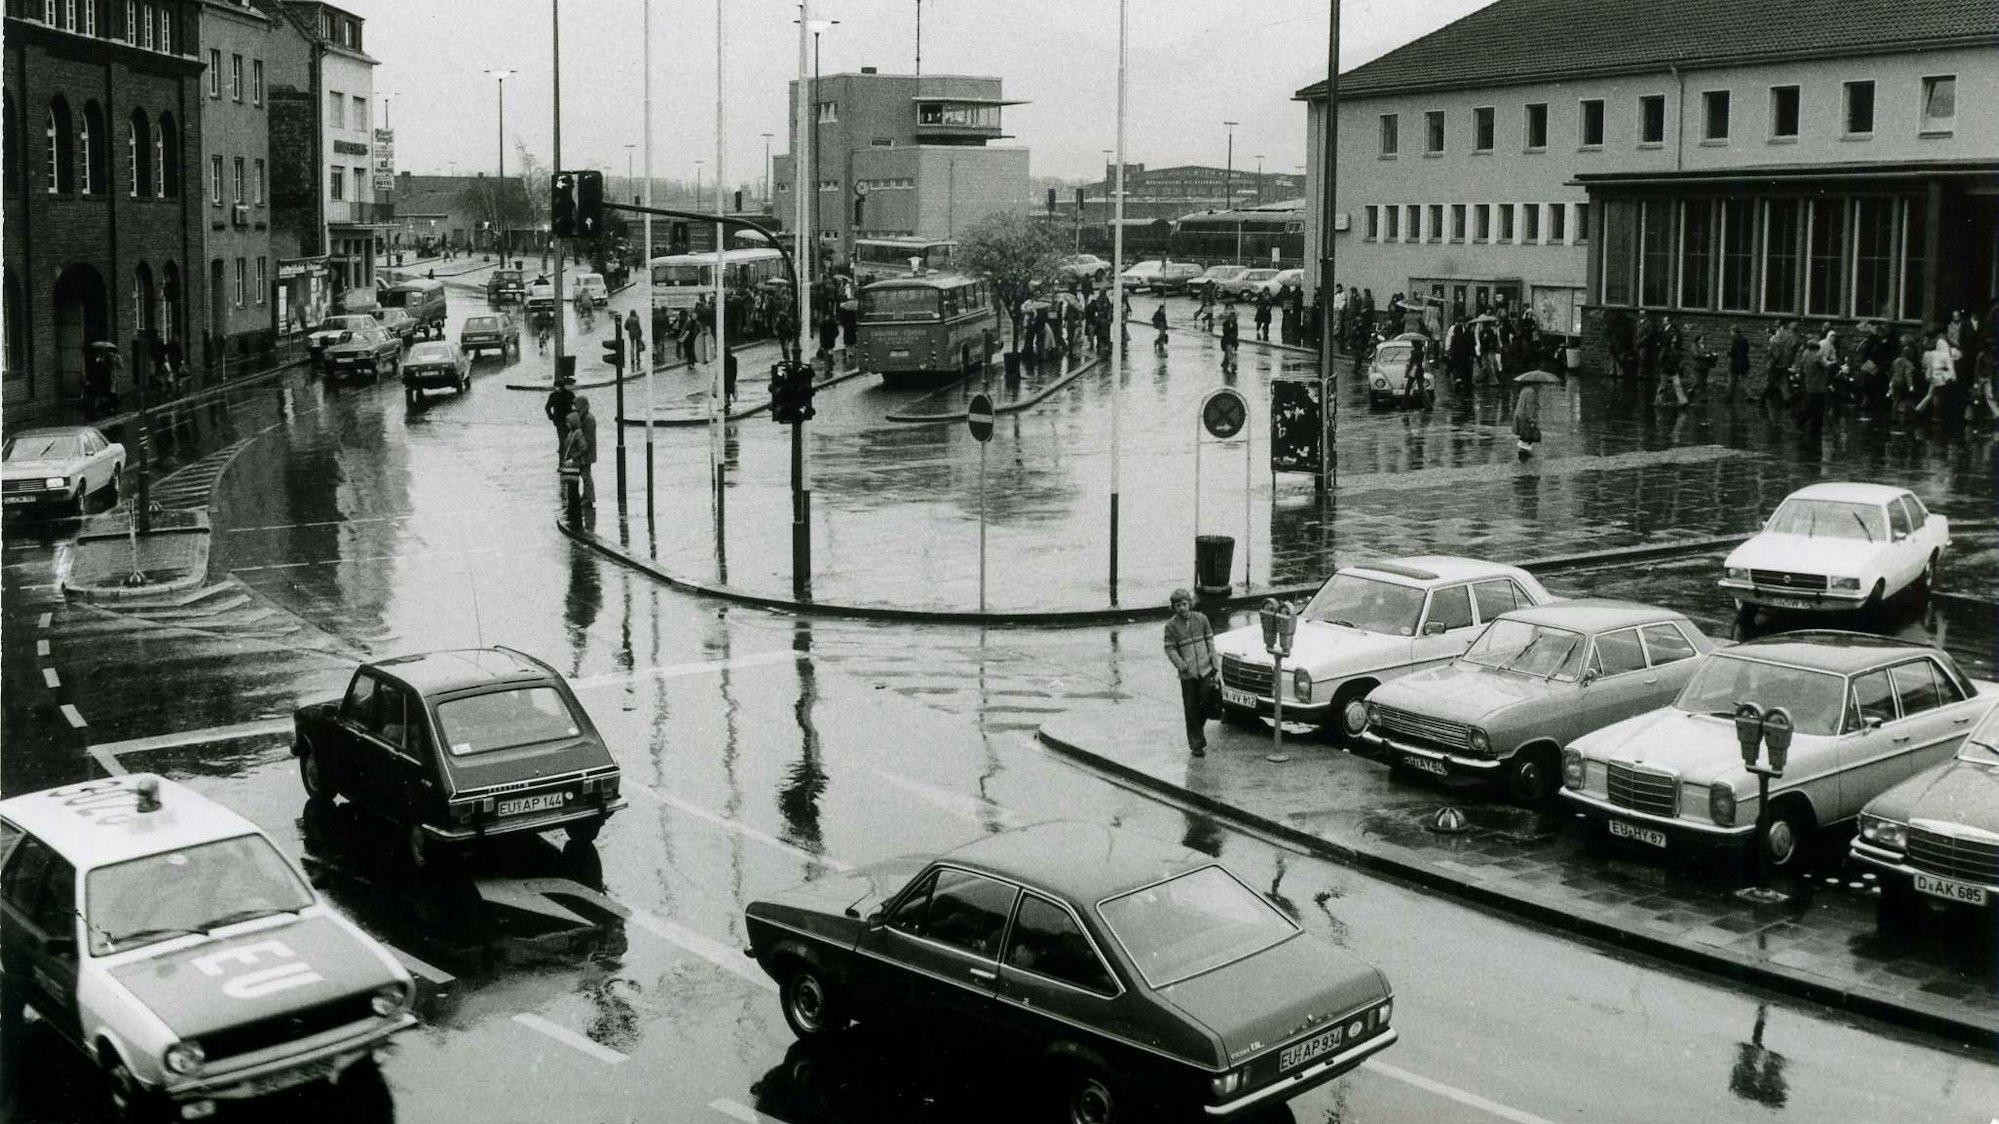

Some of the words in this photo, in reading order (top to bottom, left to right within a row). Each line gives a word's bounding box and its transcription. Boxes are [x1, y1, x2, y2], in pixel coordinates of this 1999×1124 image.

[543, 795, 563, 808] 144
[1958, 886, 1982, 901] 685
[190, 940, 325, 998] EU
[1321, 1030, 1341, 1053] 934
